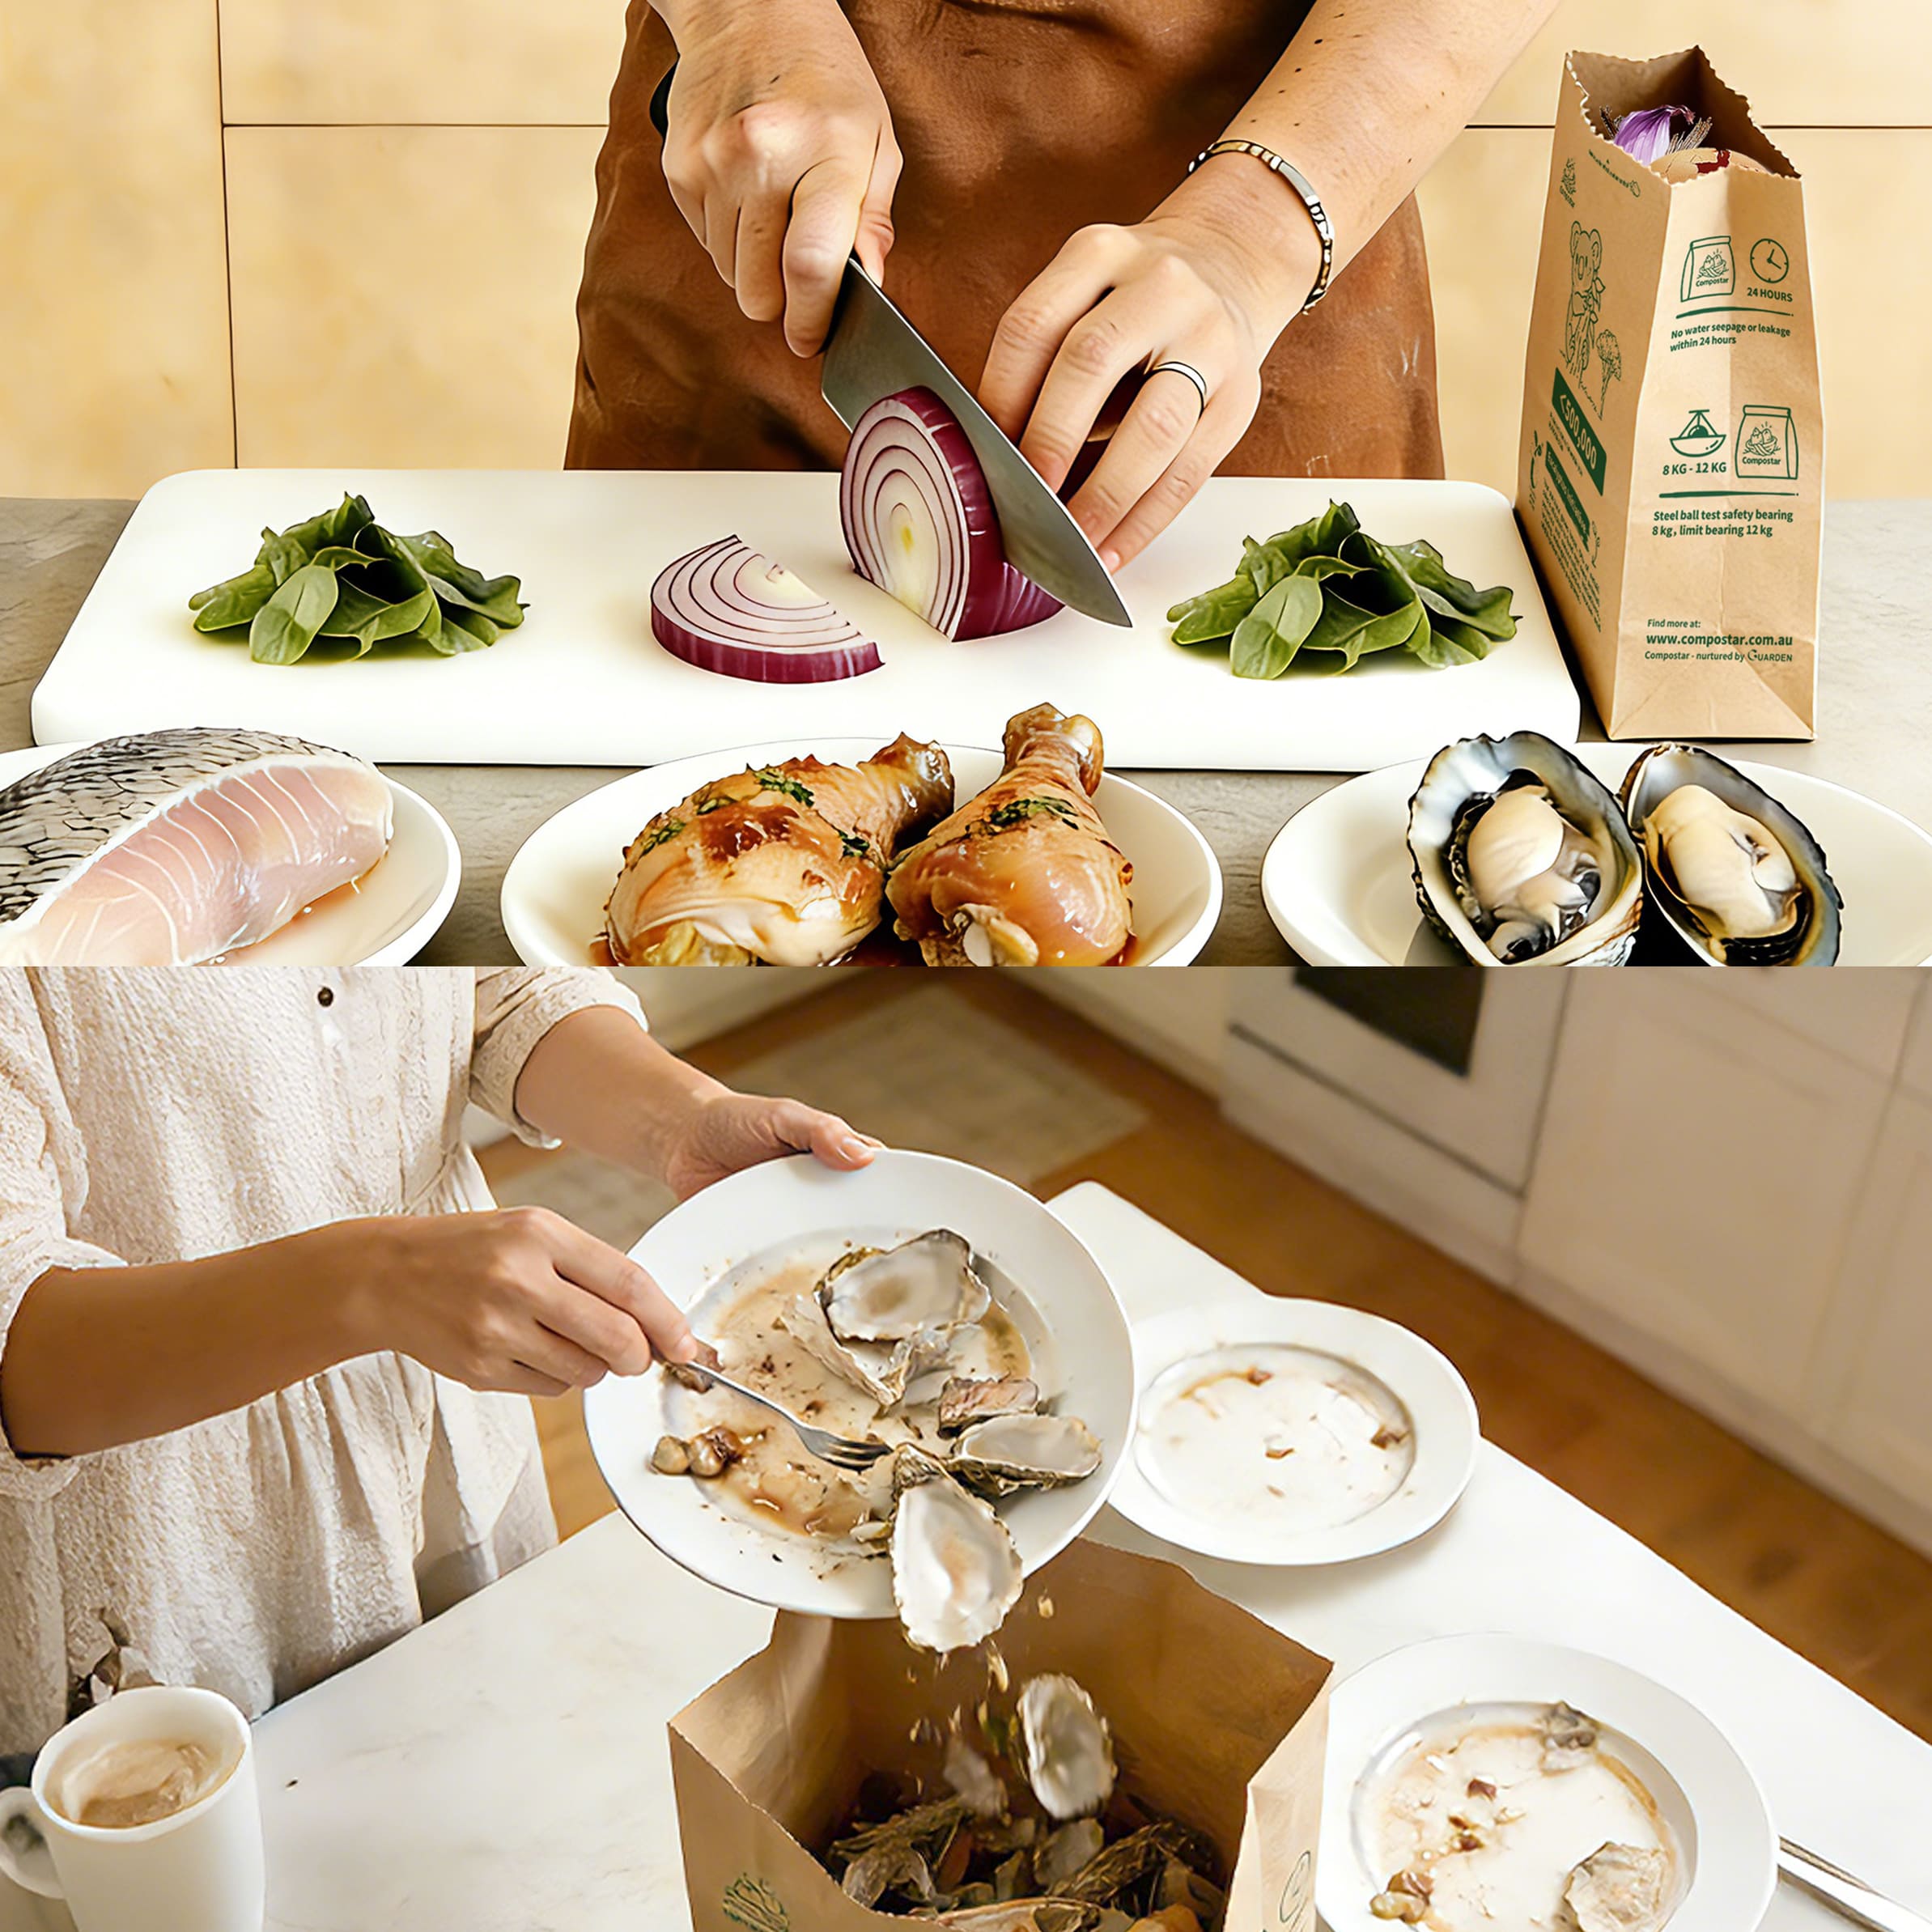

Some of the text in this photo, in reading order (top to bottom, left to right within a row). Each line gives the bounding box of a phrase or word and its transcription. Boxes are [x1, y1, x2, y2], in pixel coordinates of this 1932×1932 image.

[1696, 278, 1729, 287] Compostar
[1747, 287, 1794, 303] 24 HOURS
[1671, 323, 1790, 339] No water seepage or leakage
[1670, 336, 1736, 352] within 24 hours
[1742, 456, 1781, 465] Compostar
[1662, 465, 1670, 476] 8
[1671, 463, 1687, 475] KG
[1696, 462, 1709, 473] 12
[1711, 461, 1726, 473] KG
[1654, 508, 1794, 523] Steel ball test safety bearing
[1652, 524, 1773, 537] 8 kg, limit bearing 12 kg
[1647, 618, 1666, 628] Find
[1689, 620, 1701, 628] at:
[1646, 634, 1793, 648] www.compostar.com.au
[1645, 651, 1689, 661] Compostar
[1696, 652, 1733, 661] nurtured
[1735, 652, 1745, 662] by
[1747, 649, 1793, 661] GUARDEN
